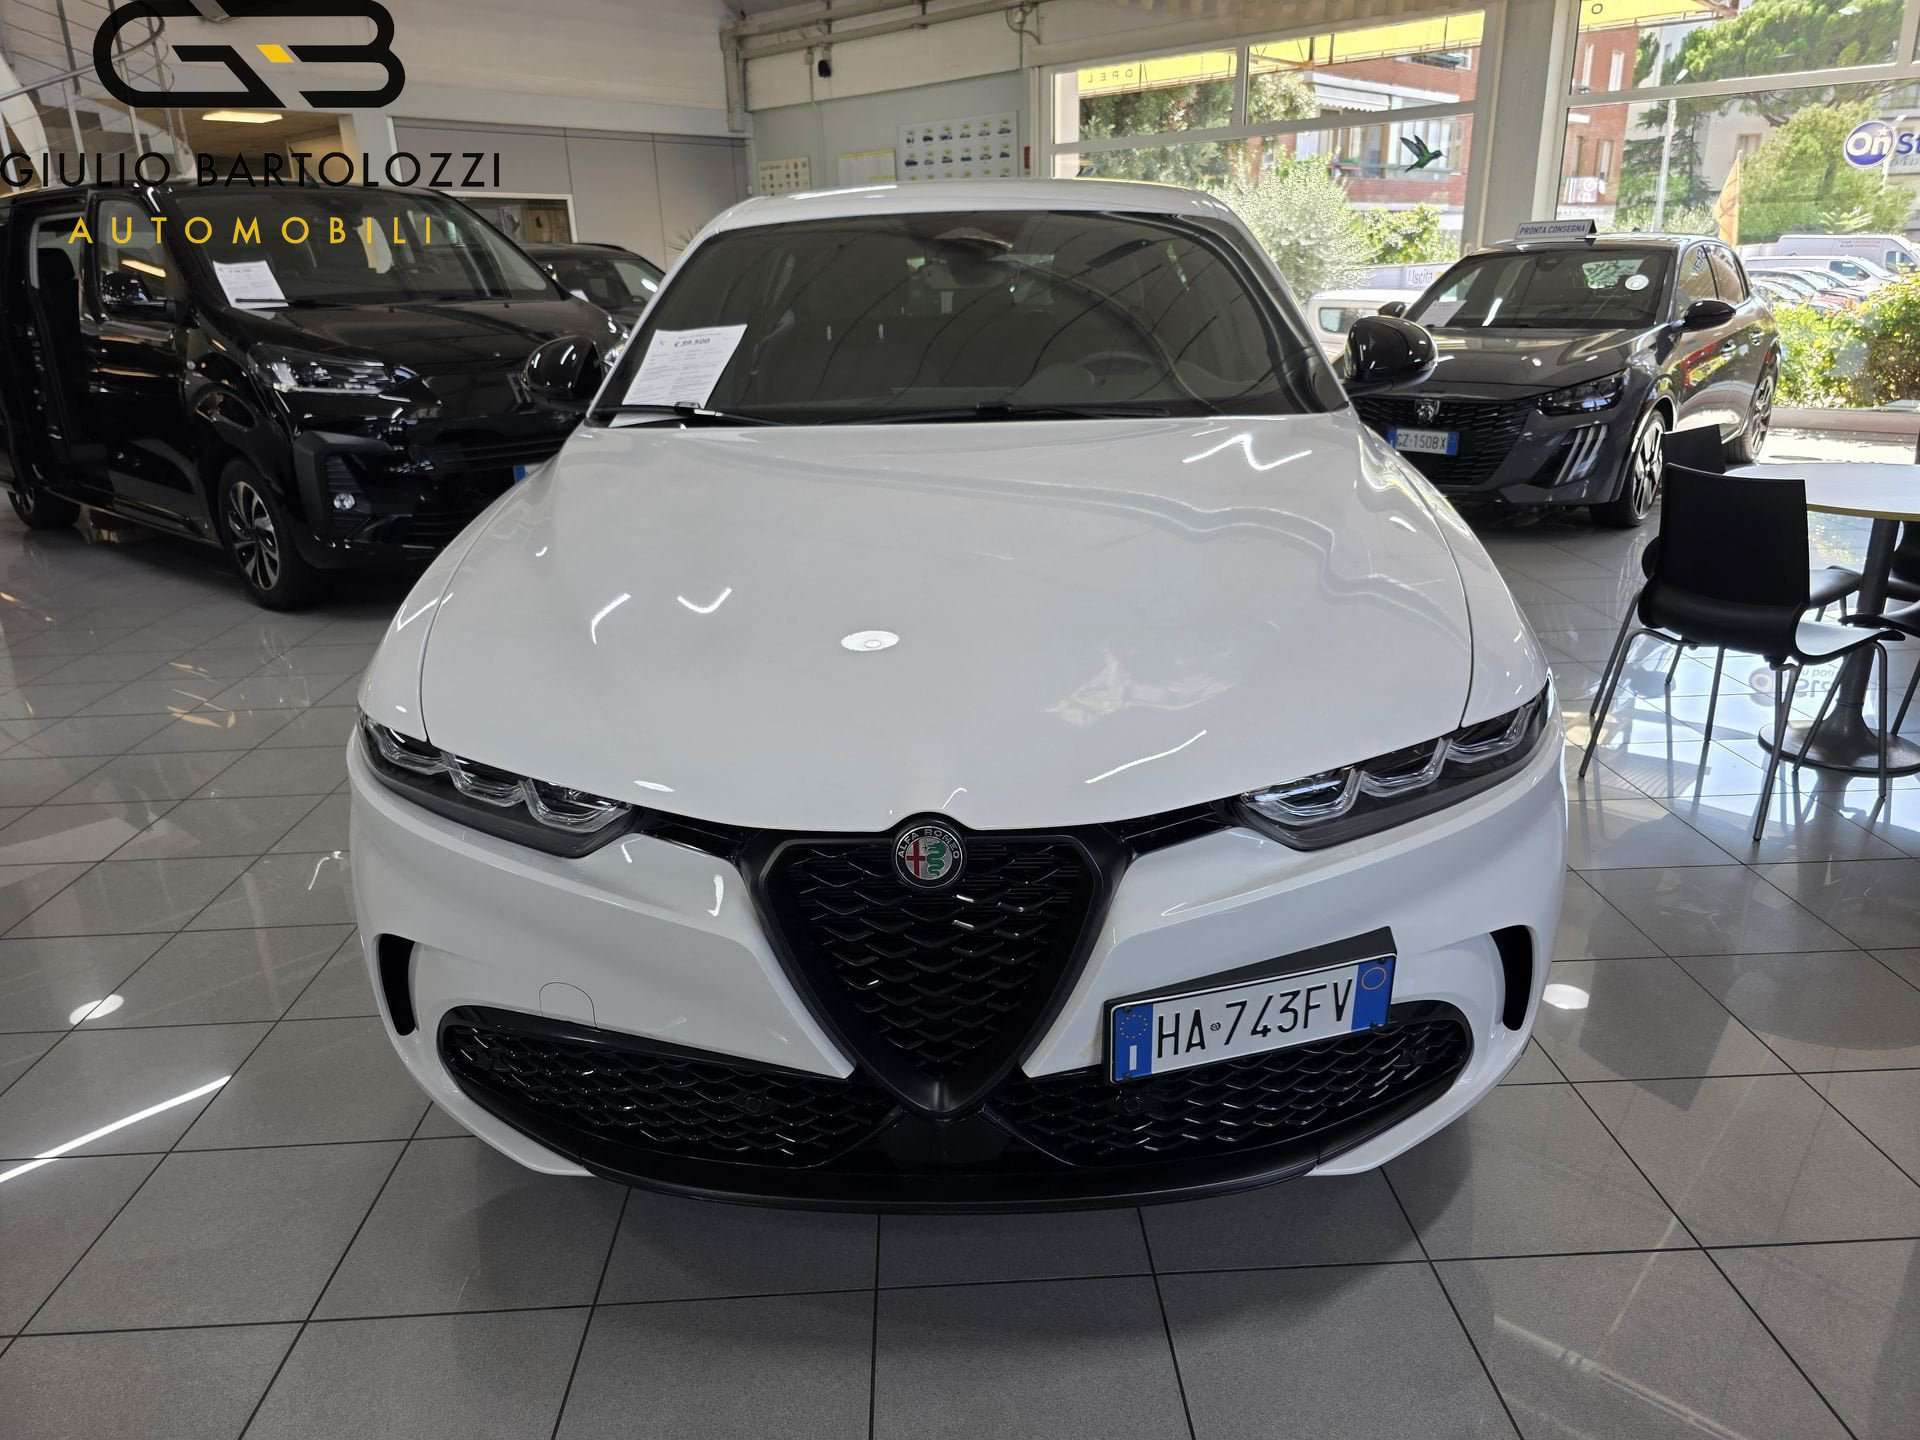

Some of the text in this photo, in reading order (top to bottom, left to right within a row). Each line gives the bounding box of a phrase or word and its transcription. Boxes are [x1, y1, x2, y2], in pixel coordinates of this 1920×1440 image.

[1519, 225, 1546, 235] PRONTA
[898, 829, 960, 860] ALFA ROMEO
